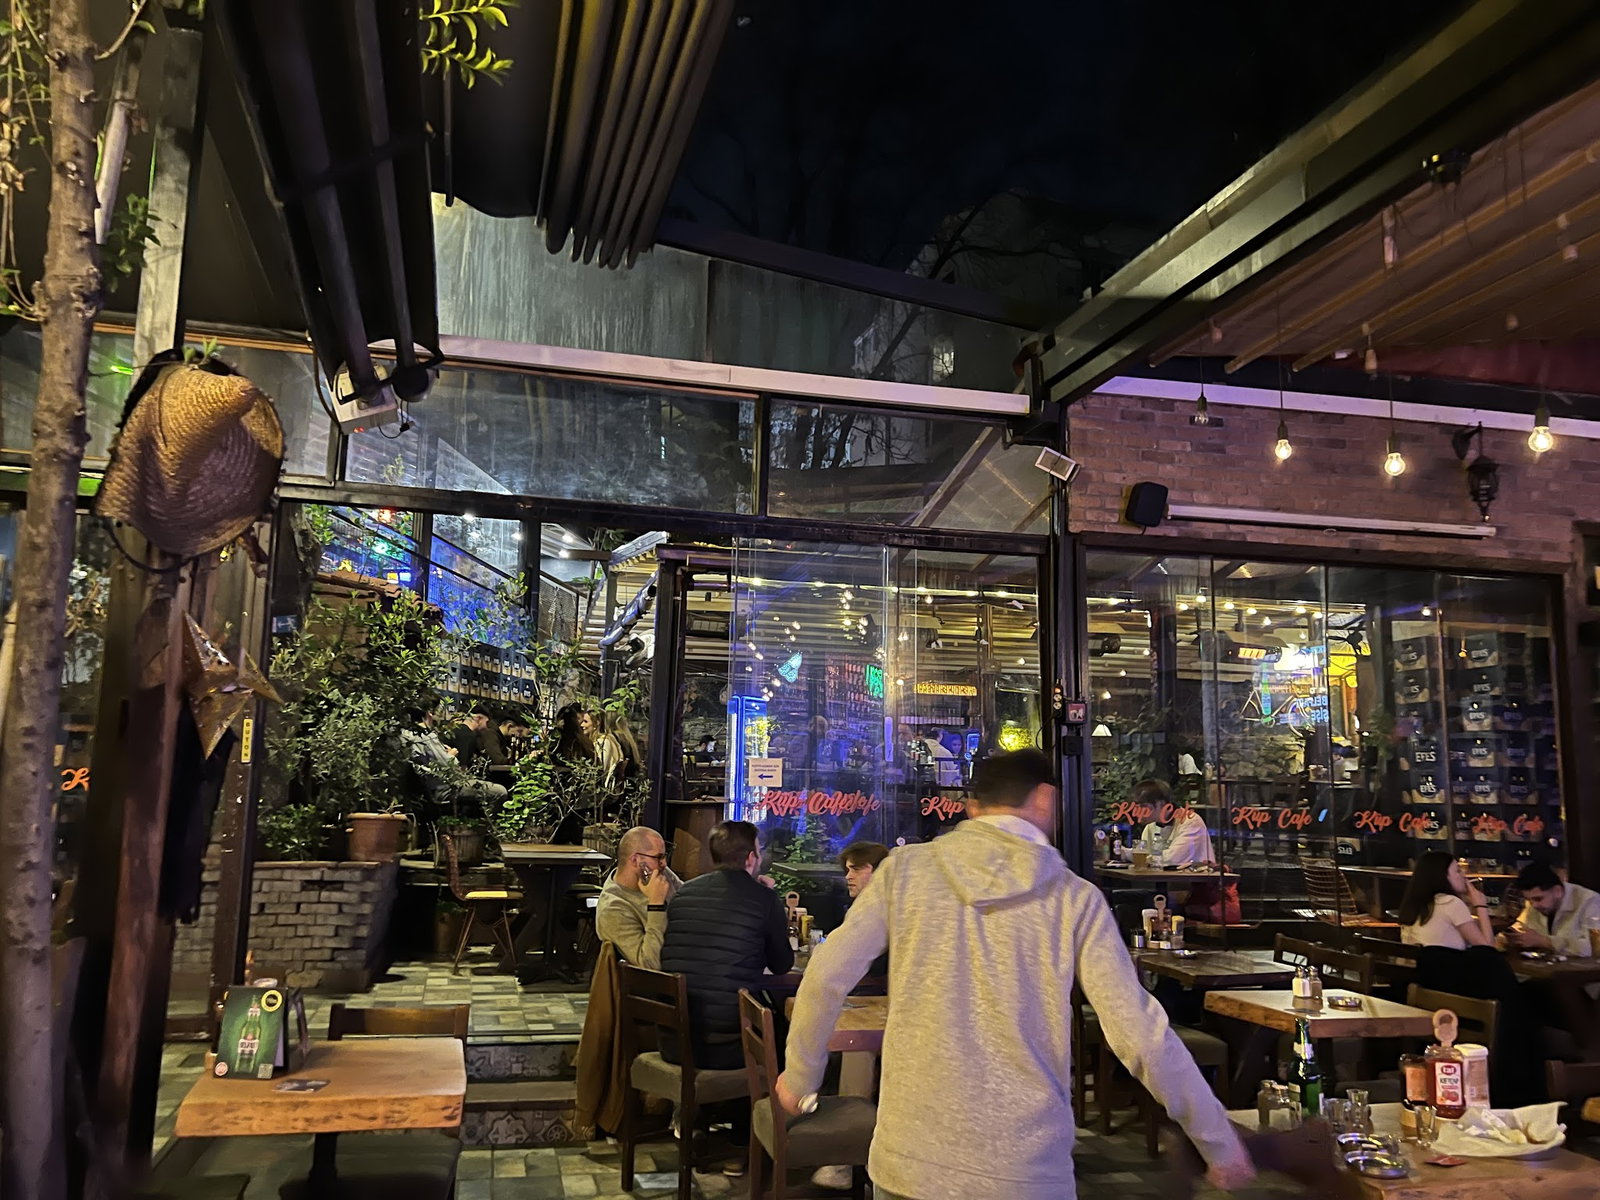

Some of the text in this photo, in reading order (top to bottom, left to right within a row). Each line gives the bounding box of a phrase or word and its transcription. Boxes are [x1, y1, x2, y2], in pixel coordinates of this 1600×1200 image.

[1415, 751, 1437, 763] EFES
[1160, 800, 1194, 825] Cafe
[1277, 807, 1312, 831] Cafe
